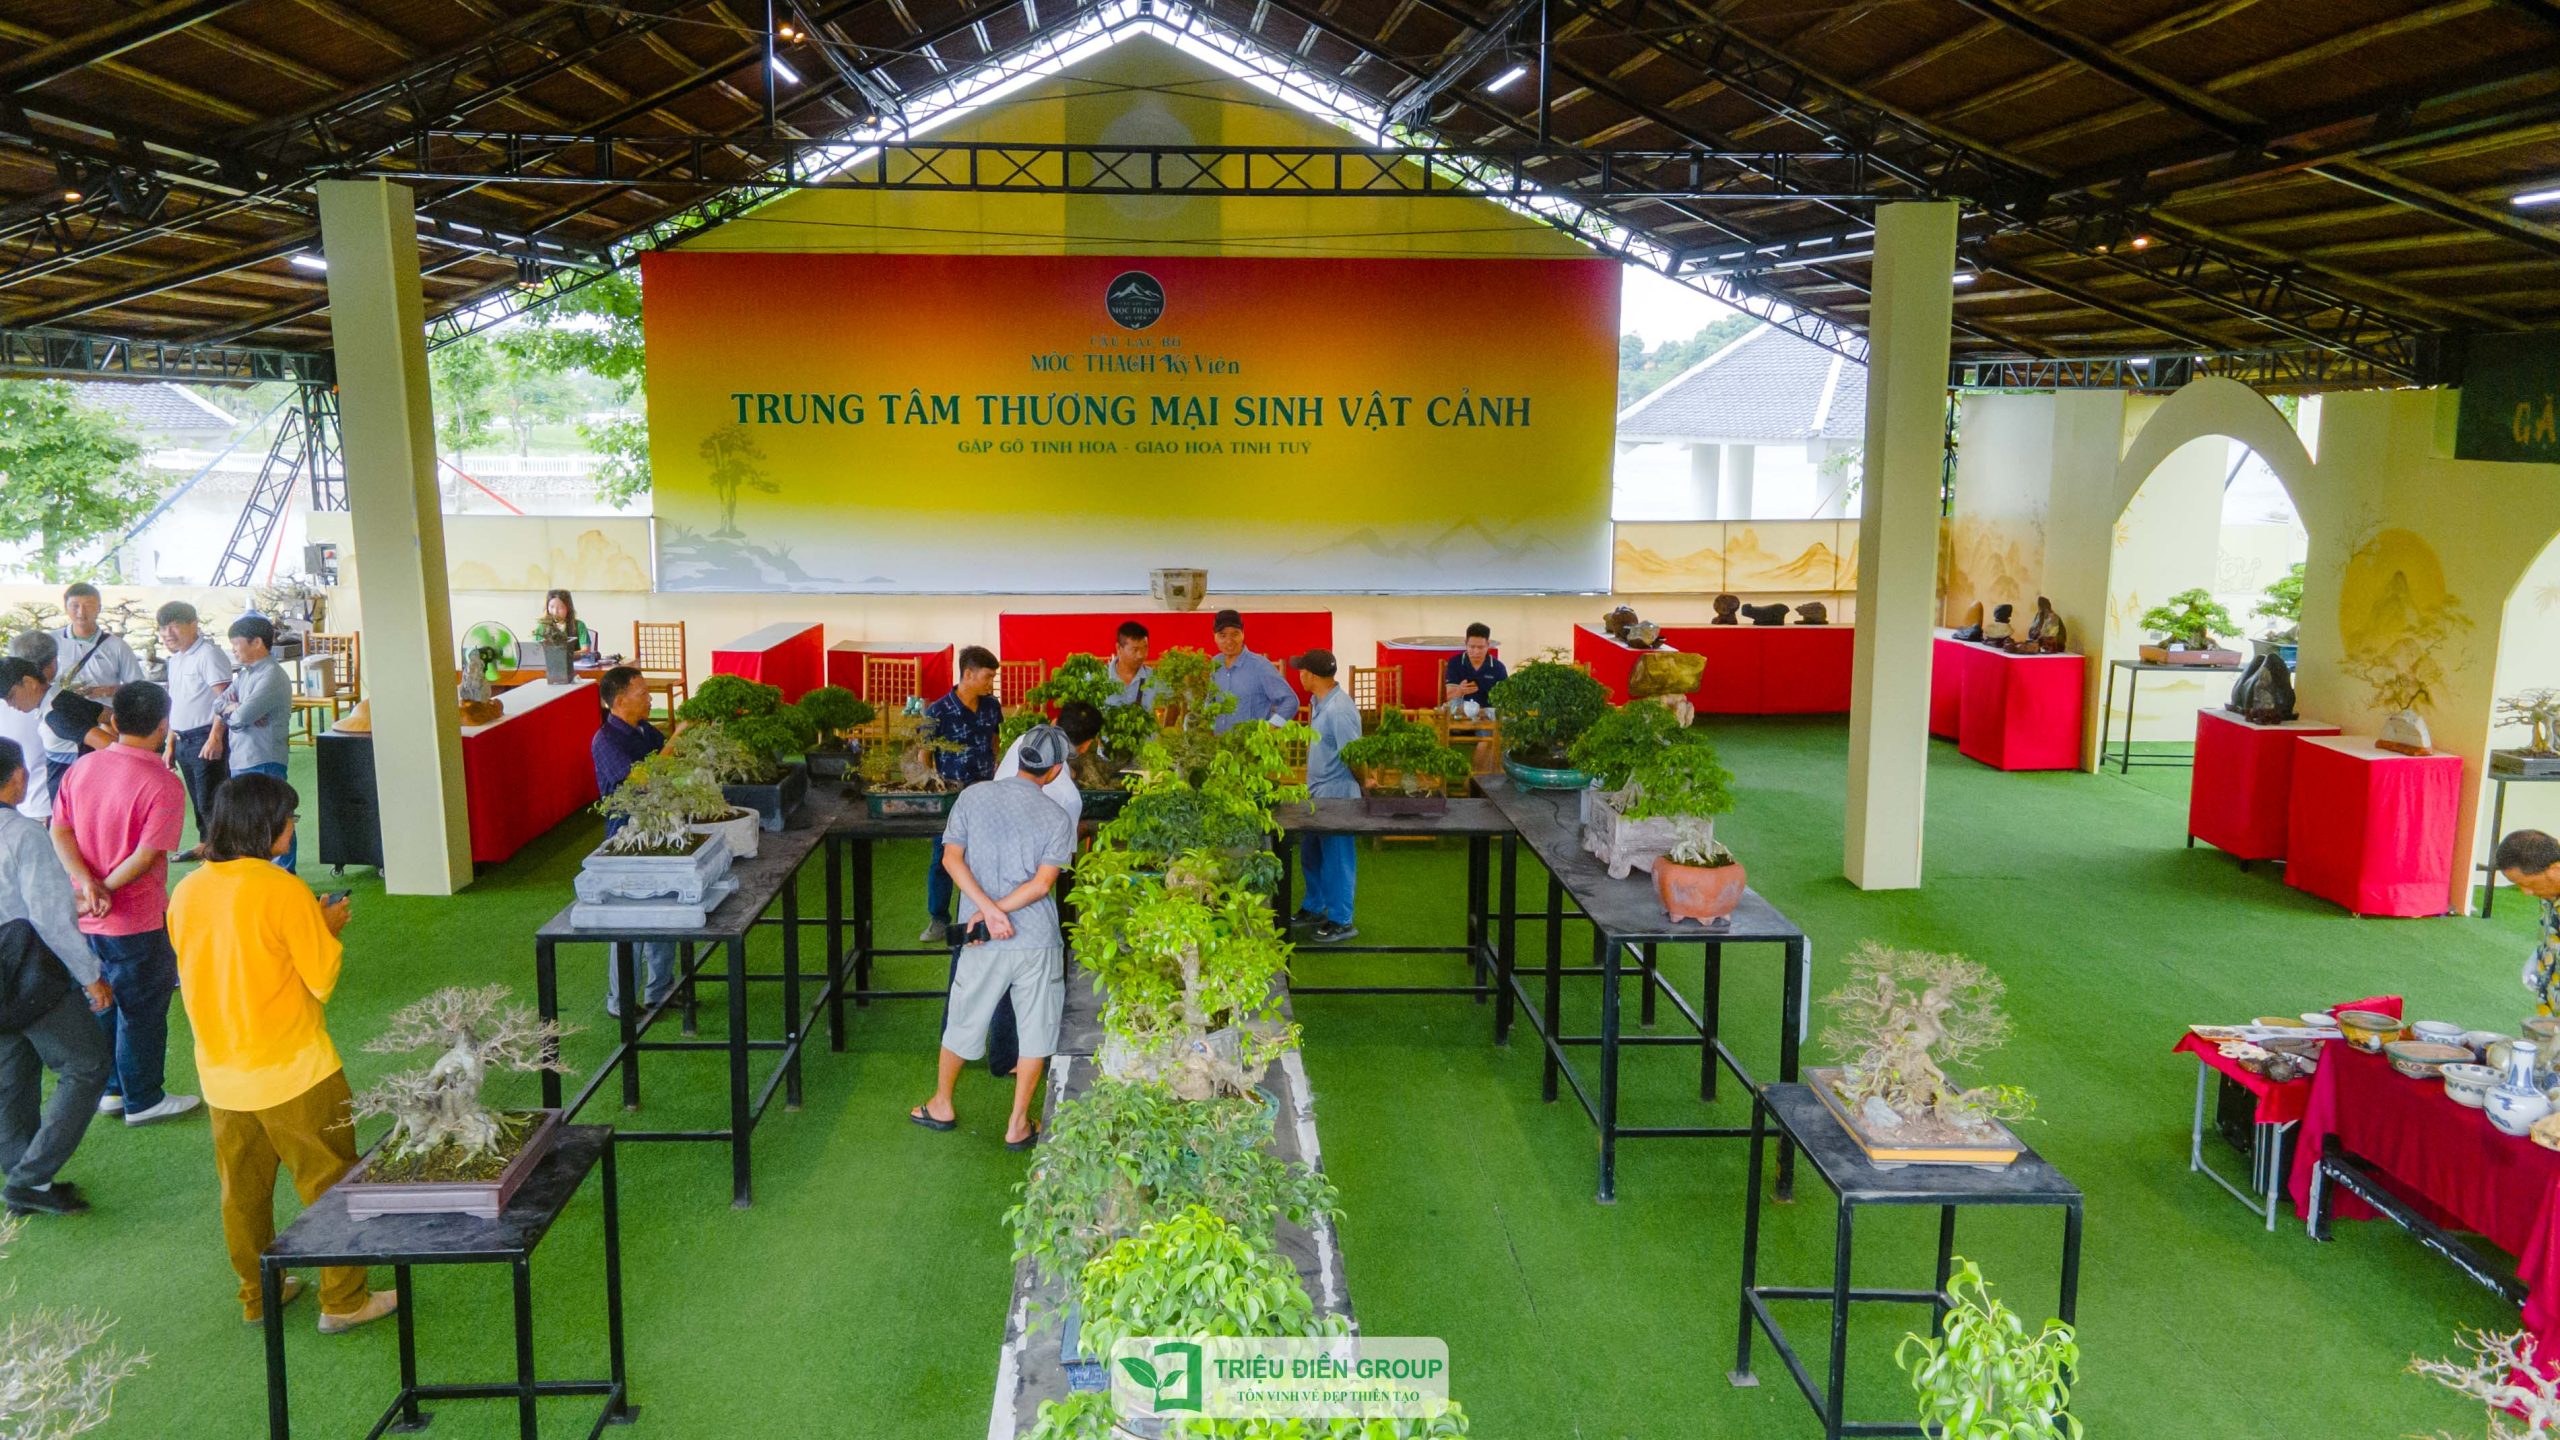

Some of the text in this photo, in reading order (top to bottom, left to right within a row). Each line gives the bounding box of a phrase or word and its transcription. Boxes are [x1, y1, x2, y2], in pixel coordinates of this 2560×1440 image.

[730, 386, 1531, 432] TRUNG TÂM THƯƠNG MẠI SINH VẬT CẢNH
[1079, 440, 1118, 454] HOA
[1134, 440, 1179, 454] GIAO
